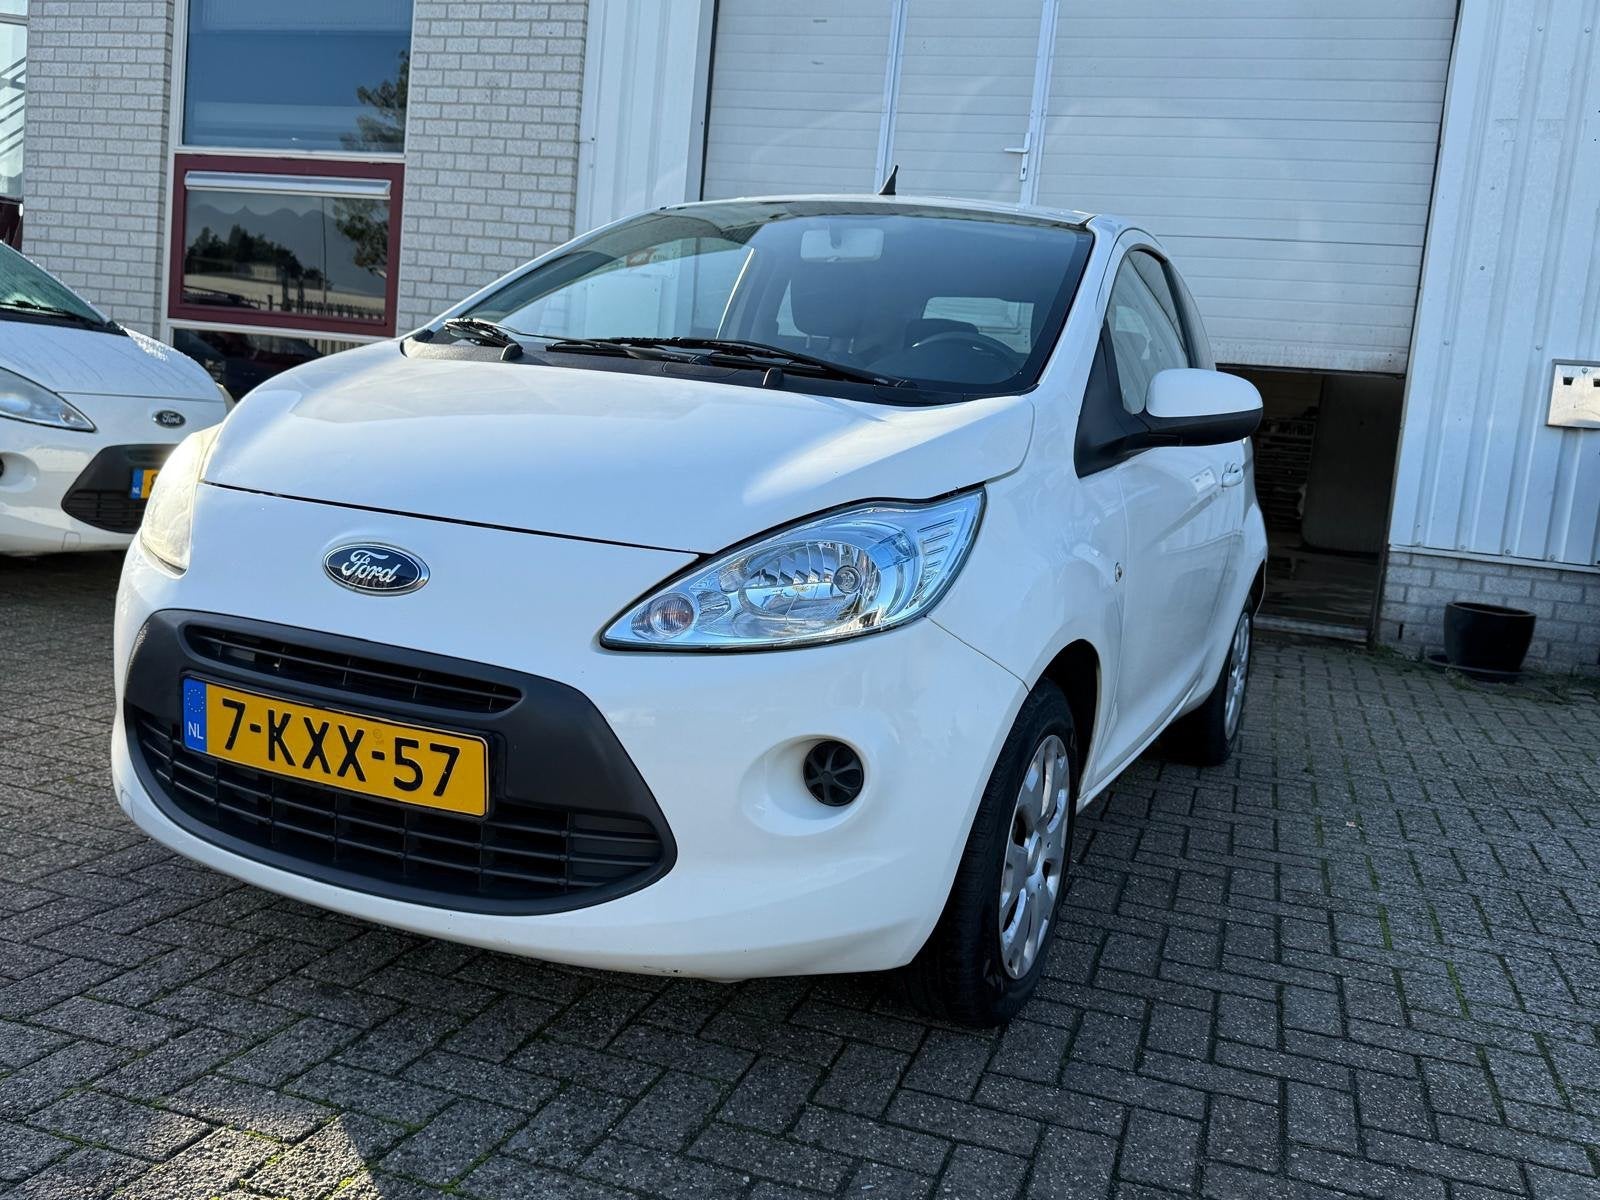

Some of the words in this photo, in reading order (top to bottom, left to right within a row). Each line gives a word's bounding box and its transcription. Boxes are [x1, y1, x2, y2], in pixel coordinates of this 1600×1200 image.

[162, 412, 180, 424] Ford
[341, 549, 401, 583] Ford
[187, 721, 204, 740] NL
[221, 698, 462, 797] 7-KXX-57
